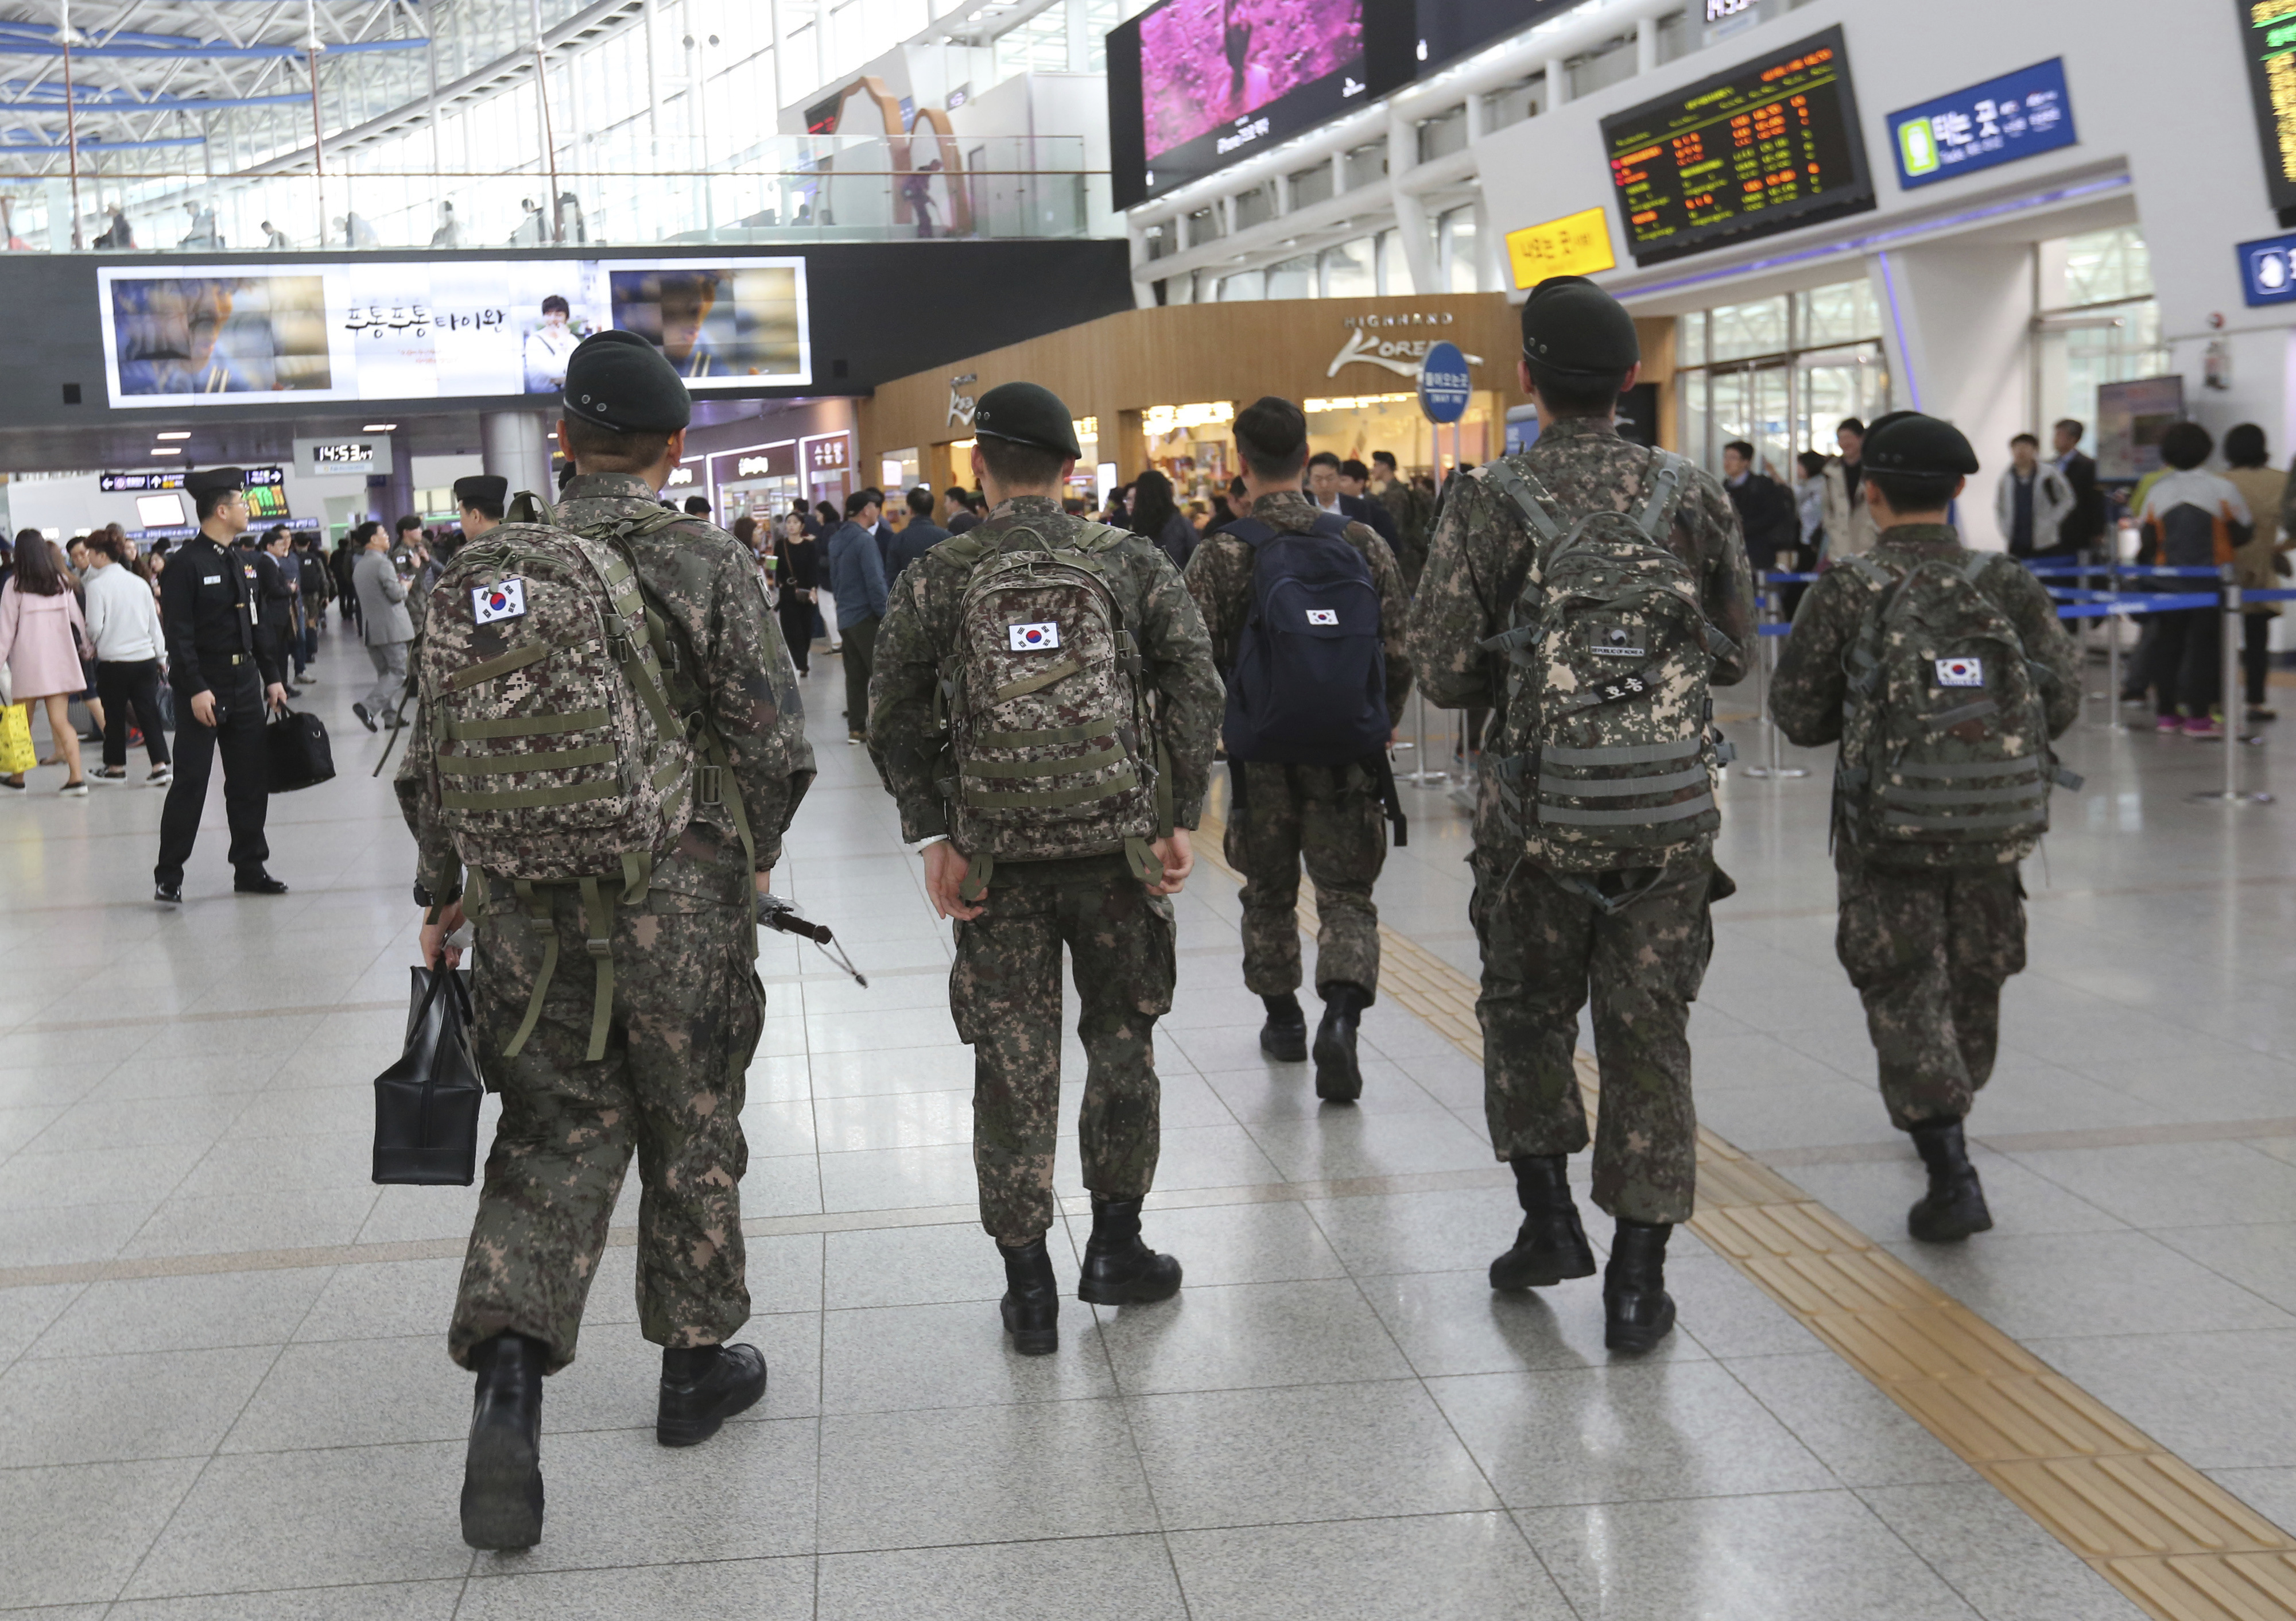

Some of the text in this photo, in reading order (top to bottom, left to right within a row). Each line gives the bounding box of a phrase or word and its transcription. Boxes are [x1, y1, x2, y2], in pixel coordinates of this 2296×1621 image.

[1931, 111, 1974, 146] 타는
[1974, 99, 2001, 138] 곳
[435, 309, 506, 333] 타이완
[319, 444, 360, 462] 14:53
